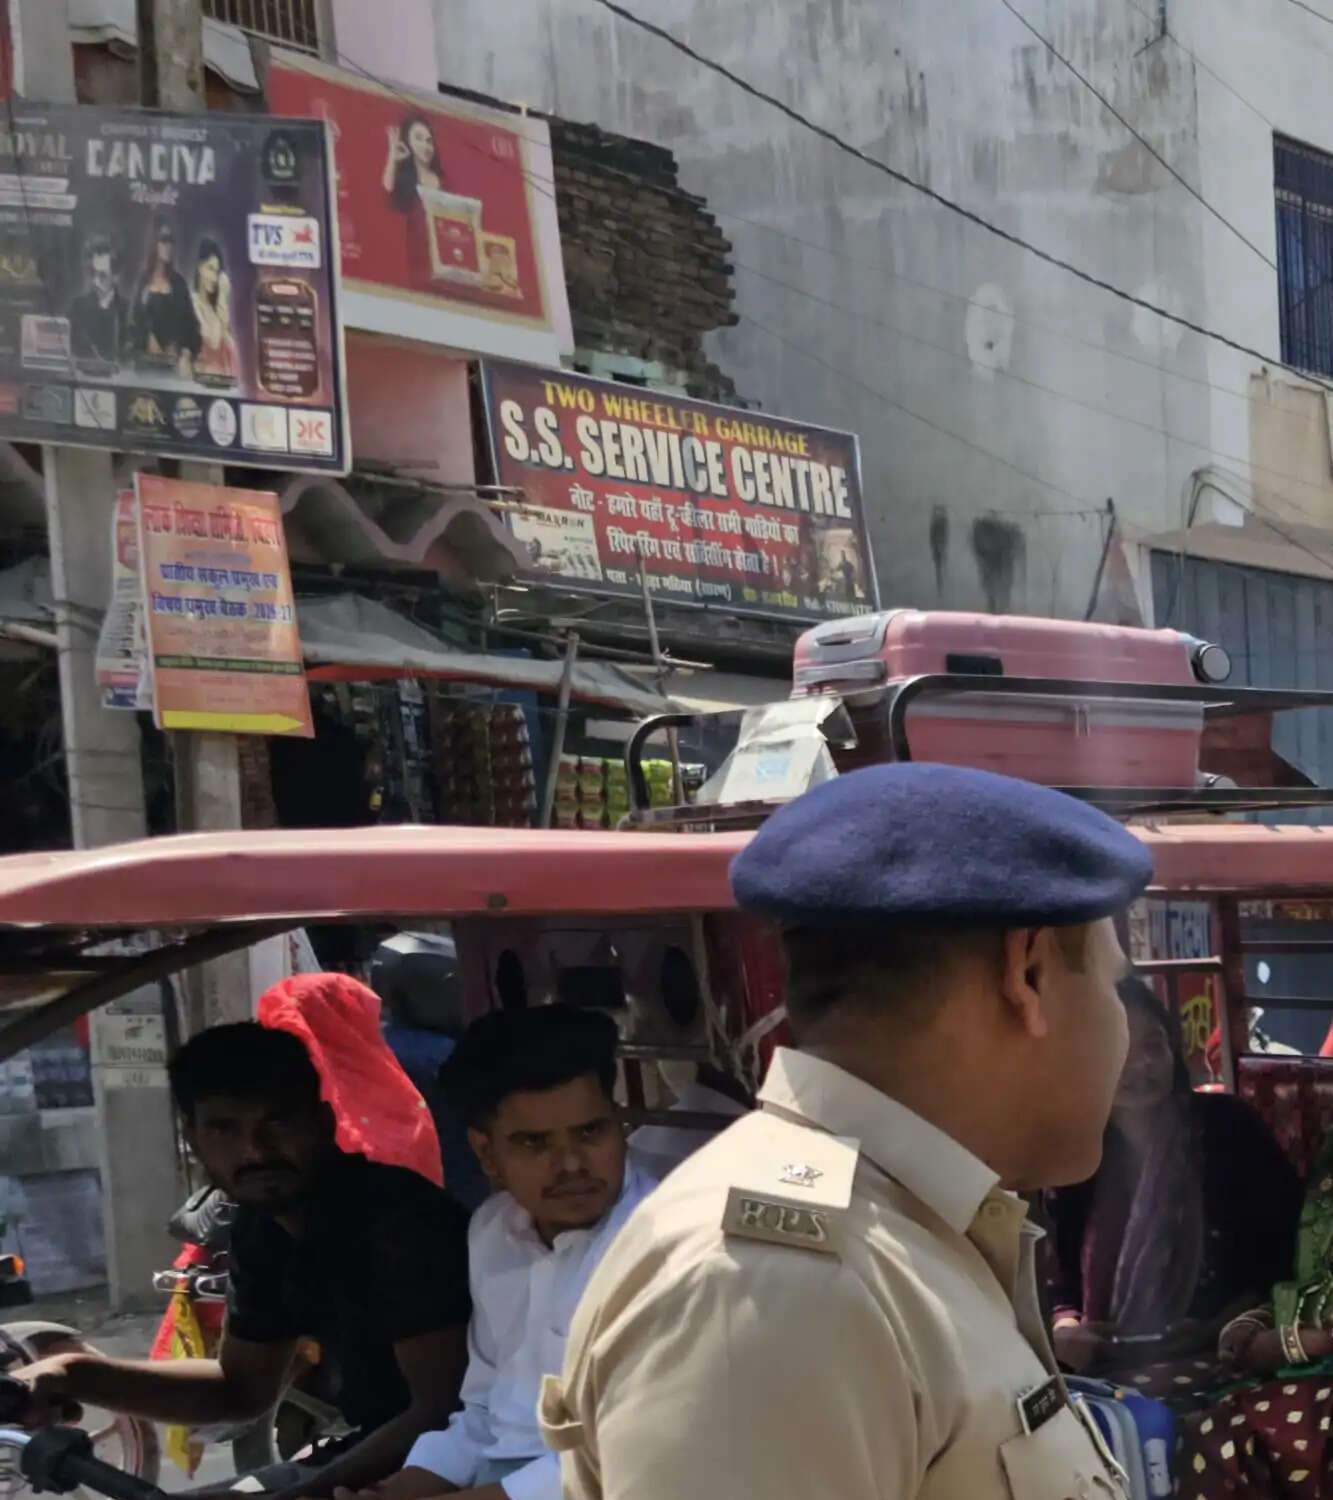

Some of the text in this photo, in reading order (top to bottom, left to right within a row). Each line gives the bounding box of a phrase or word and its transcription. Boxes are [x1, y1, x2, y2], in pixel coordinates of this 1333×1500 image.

[251, 222, 283, 246] TVS
[542, 380, 810, 457] TWO WHEELER GARRAGE
[500, 399, 852, 520] S.S. SERVICE CENTRE
[605, 491, 639, 519] हमारे
